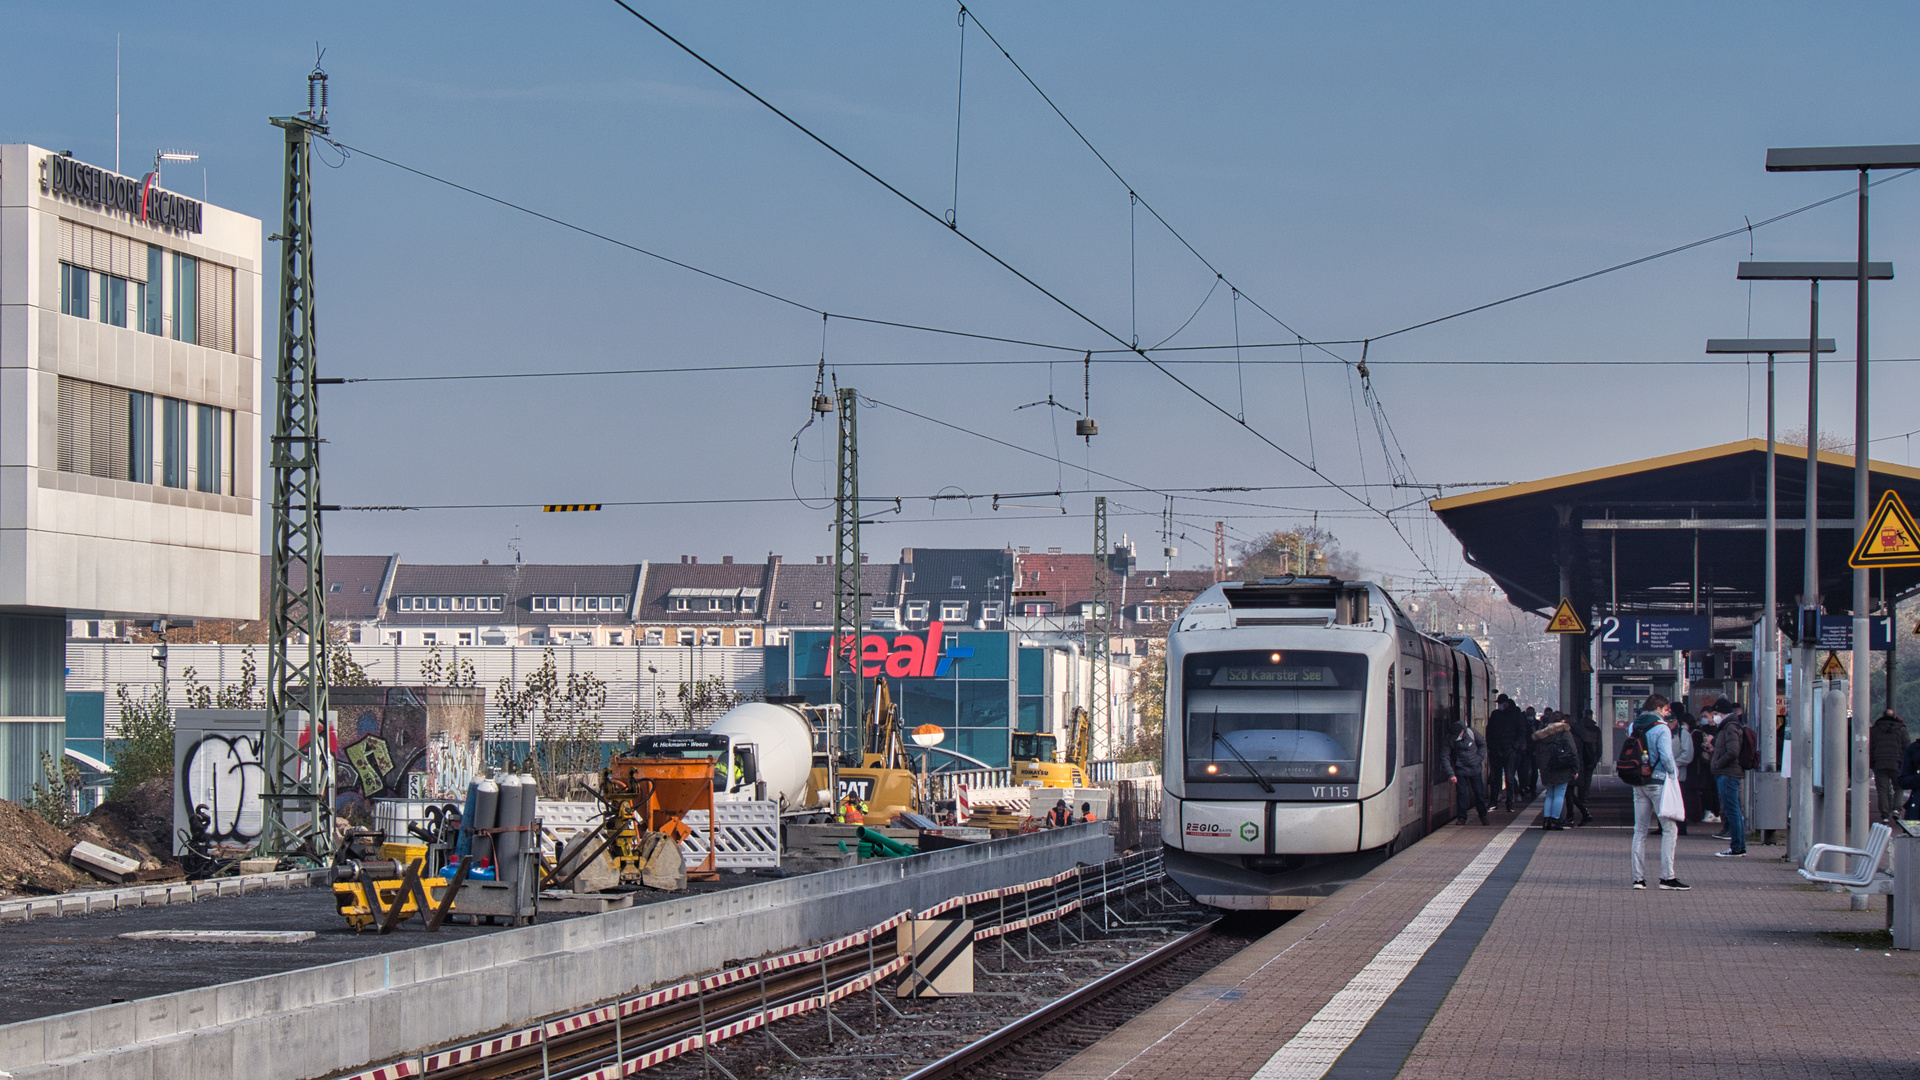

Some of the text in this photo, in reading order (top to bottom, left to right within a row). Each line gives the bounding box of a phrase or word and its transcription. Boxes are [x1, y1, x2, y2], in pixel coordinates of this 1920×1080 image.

[1602, 617, 1620, 642] 2
[1880, 616, 1892, 643] 1
[1229, 669, 1322, 681] S28 Kaarster See
[839, 780, 869, 802] CAT
[1312, 786, 1349, 798] VT 115
